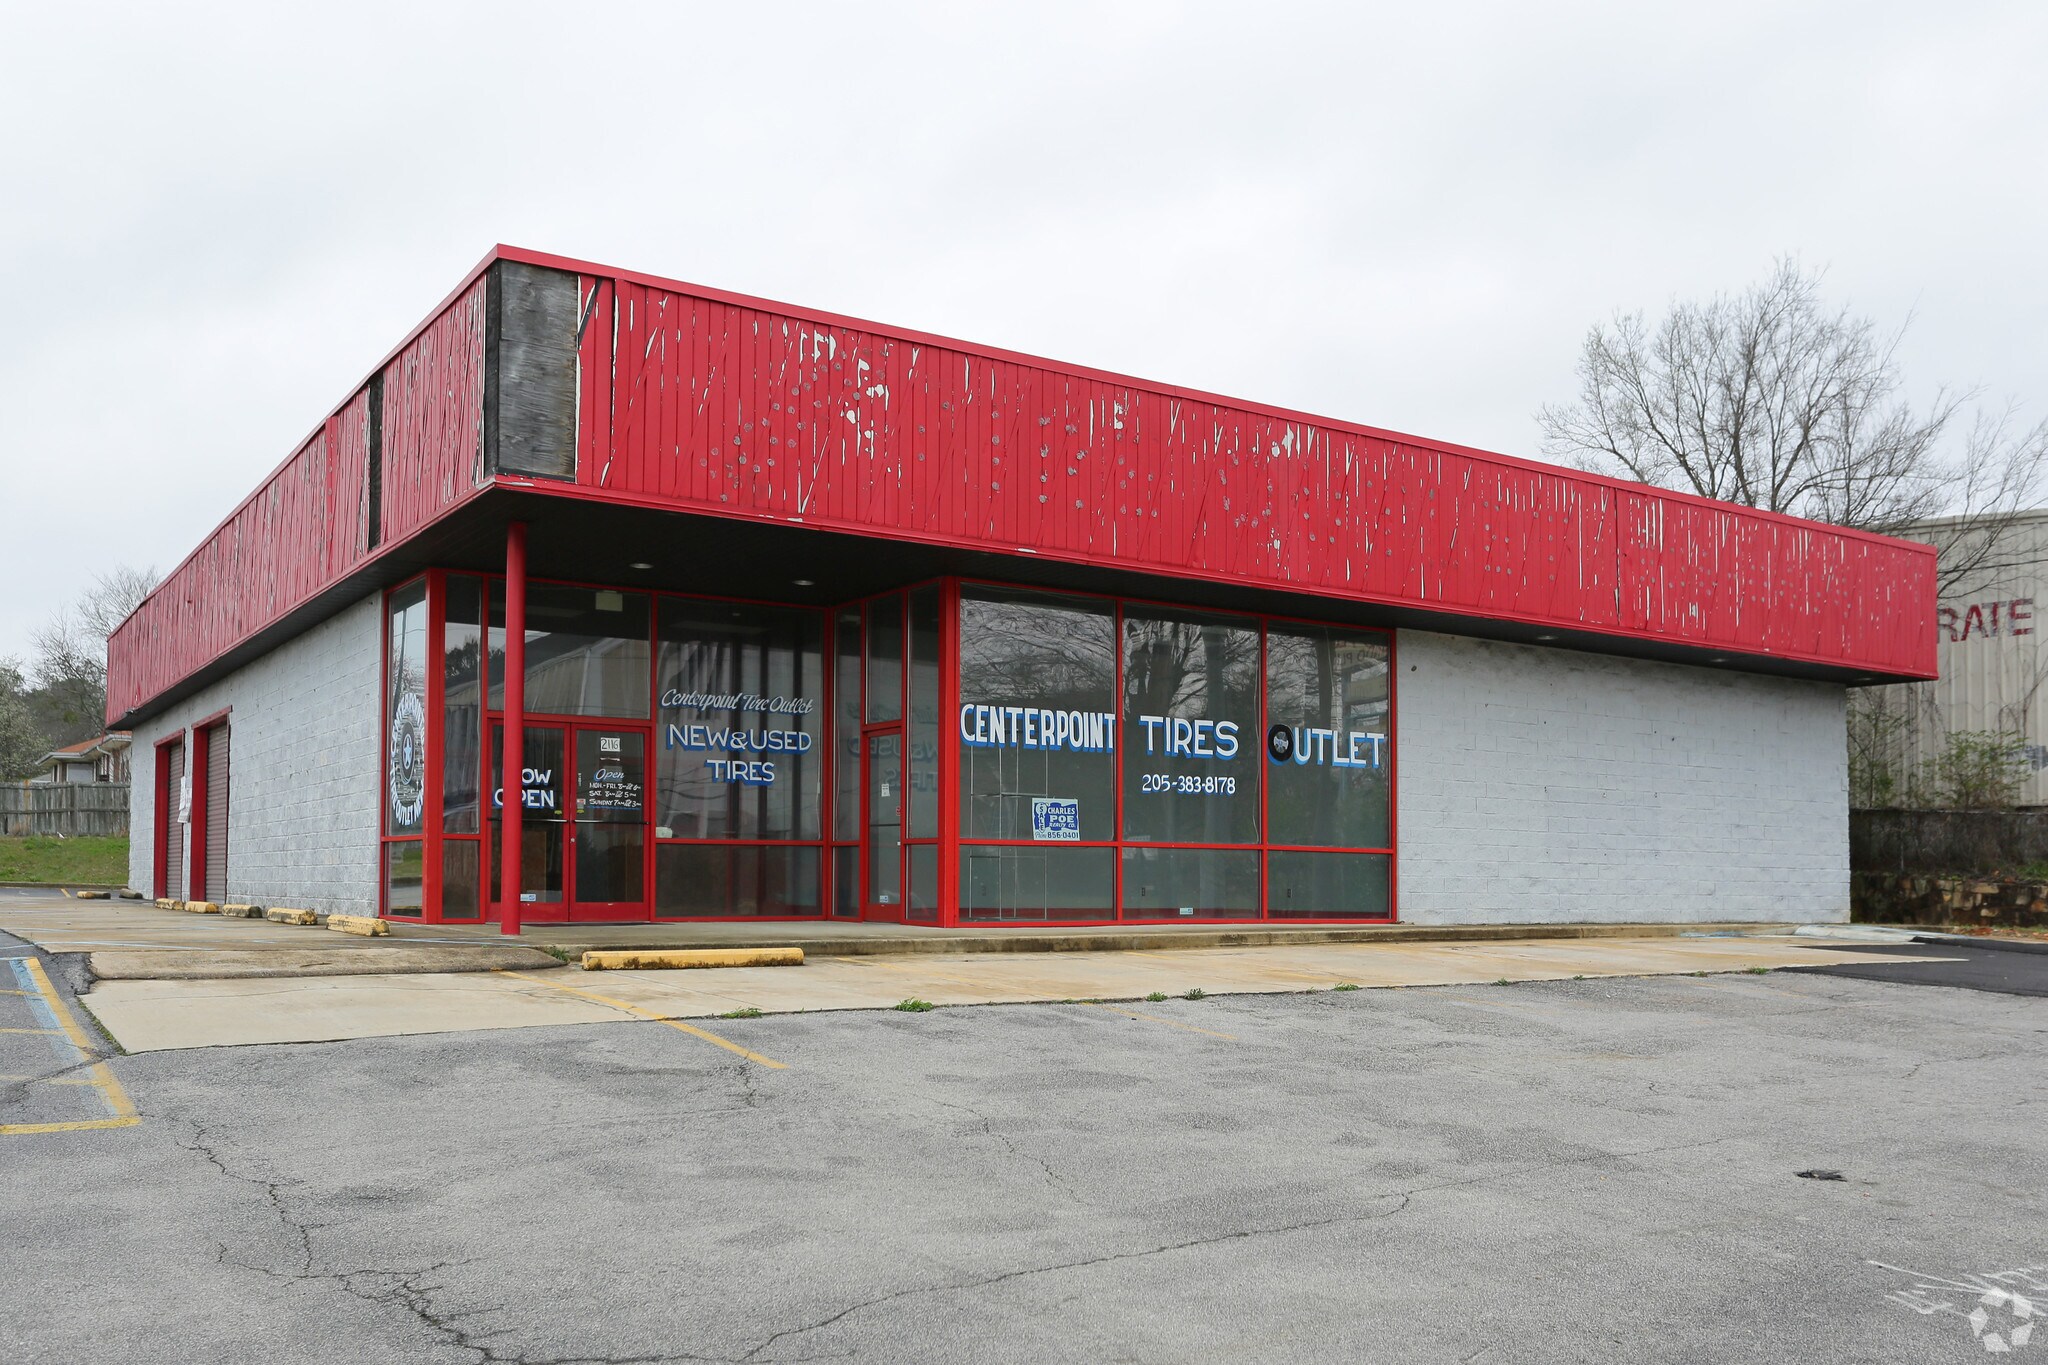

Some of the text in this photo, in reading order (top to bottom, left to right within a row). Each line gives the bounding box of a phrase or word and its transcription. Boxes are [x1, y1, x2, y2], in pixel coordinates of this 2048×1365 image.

[661, 688, 813, 714] Centerpoint Tire Outlet
[960, 703, 1116, 752] CENTERPOINT
[1139, 715, 1239, 759] TIRES
[1267, 724, 1385, 767] OUTLET
[601, 738, 619, 750] 2116
[522, 768, 552, 785] OW
[595, 768, 624, 780] Open
[705, 759, 776, 784] TIRES
[1142, 774, 1236, 795] 205-383-8178
[1048, 807, 1076, 815] CHARLES
[1050, 815, 1075, 823] POE
